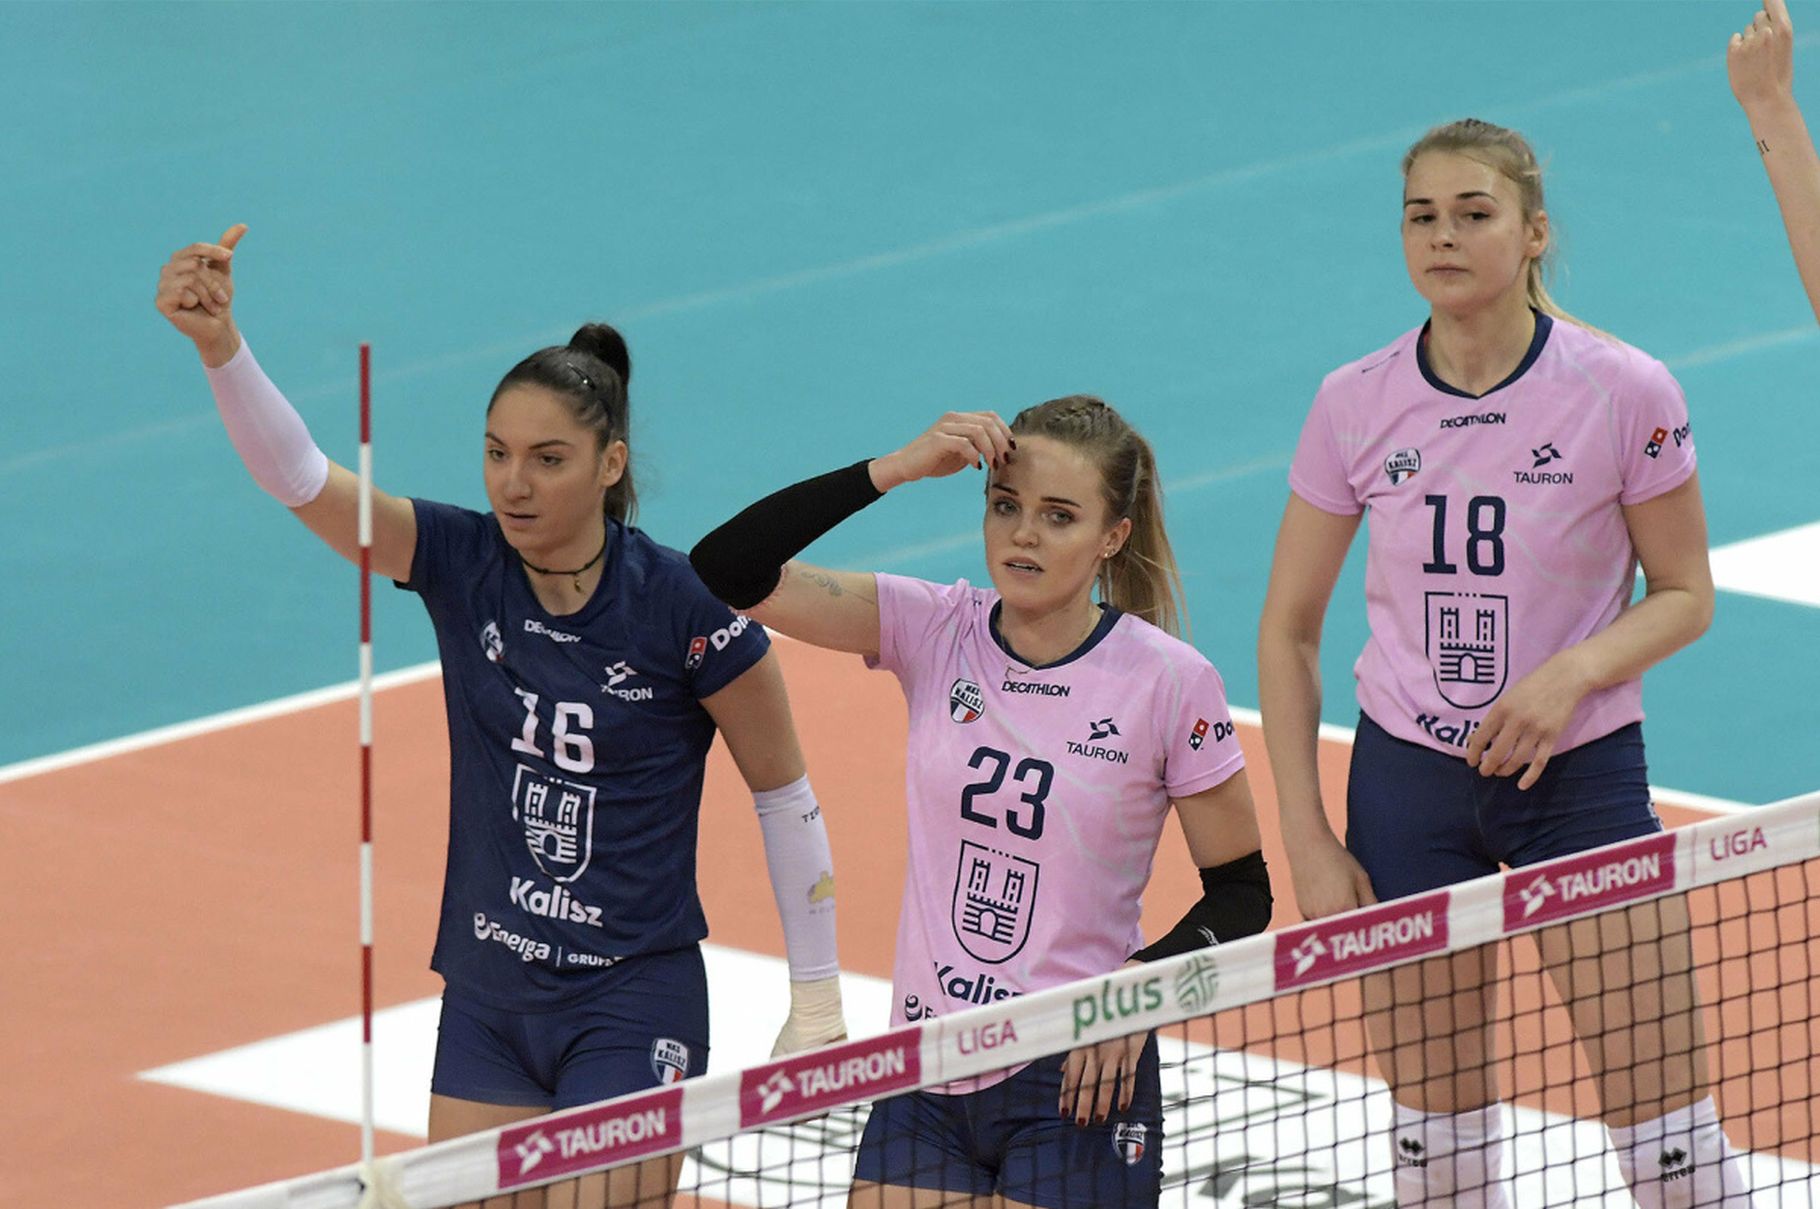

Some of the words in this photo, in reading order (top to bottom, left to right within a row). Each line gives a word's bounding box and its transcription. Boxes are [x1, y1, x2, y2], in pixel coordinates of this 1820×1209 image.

[1673, 422, 1691, 448] Do
[1513, 471, 1574, 485] TAURON
[1423, 494, 1507, 577] 18
[953, 687, 984, 710] KALISZ
[1001, 680, 1071, 697] DECATHLON
[511, 686, 595, 774] 16
[1066, 741, 1129, 765] TAURON
[1213, 719, 1235, 743] Do
[961, 746, 1055, 841] 23
[1558, 853, 1661, 902] TAURON
[1710, 826, 1768, 861] LIGA
[510, 876, 604, 928] Kalisz
[489, 921, 551, 962] Energa
[1329, 911, 1434, 961] TAURON
[1072, 978, 1163, 1041] plus
[796, 1047, 905, 1099] TAURON
[958, 1019, 1018, 1055] LIGA
[555, 1109, 666, 1159] TAURON
